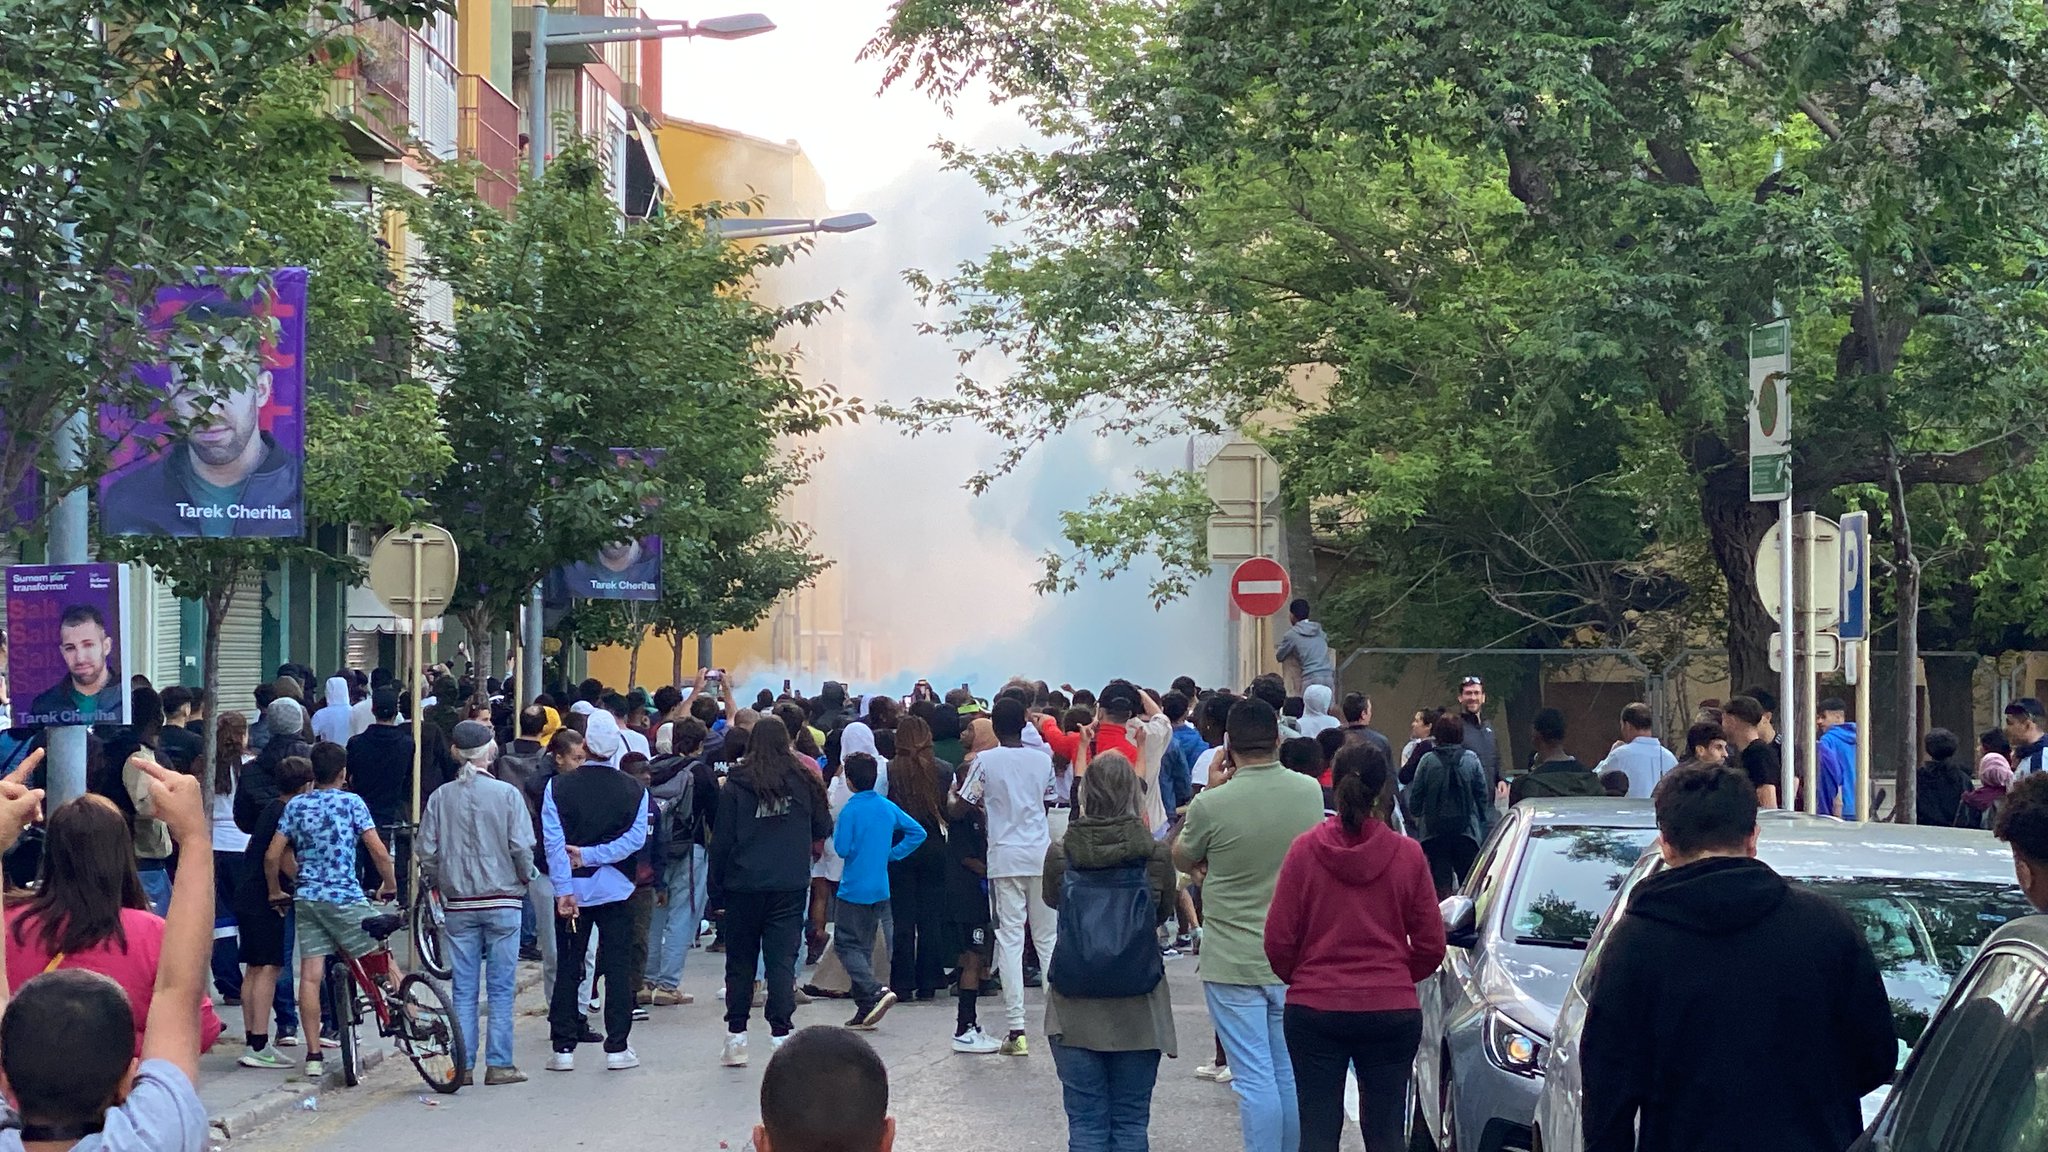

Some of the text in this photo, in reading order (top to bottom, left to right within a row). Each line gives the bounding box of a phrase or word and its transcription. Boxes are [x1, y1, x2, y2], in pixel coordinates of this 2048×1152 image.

[176, 503, 291, 520] Tarek Cheriha
[13, 574, 48, 583] Sumem
[1844, 530, 1858, 623] P
[13, 583, 69, 592] transformar
[590, 580, 656, 590] Tarek Cheriha
[18, 711, 59, 724] Tarek
